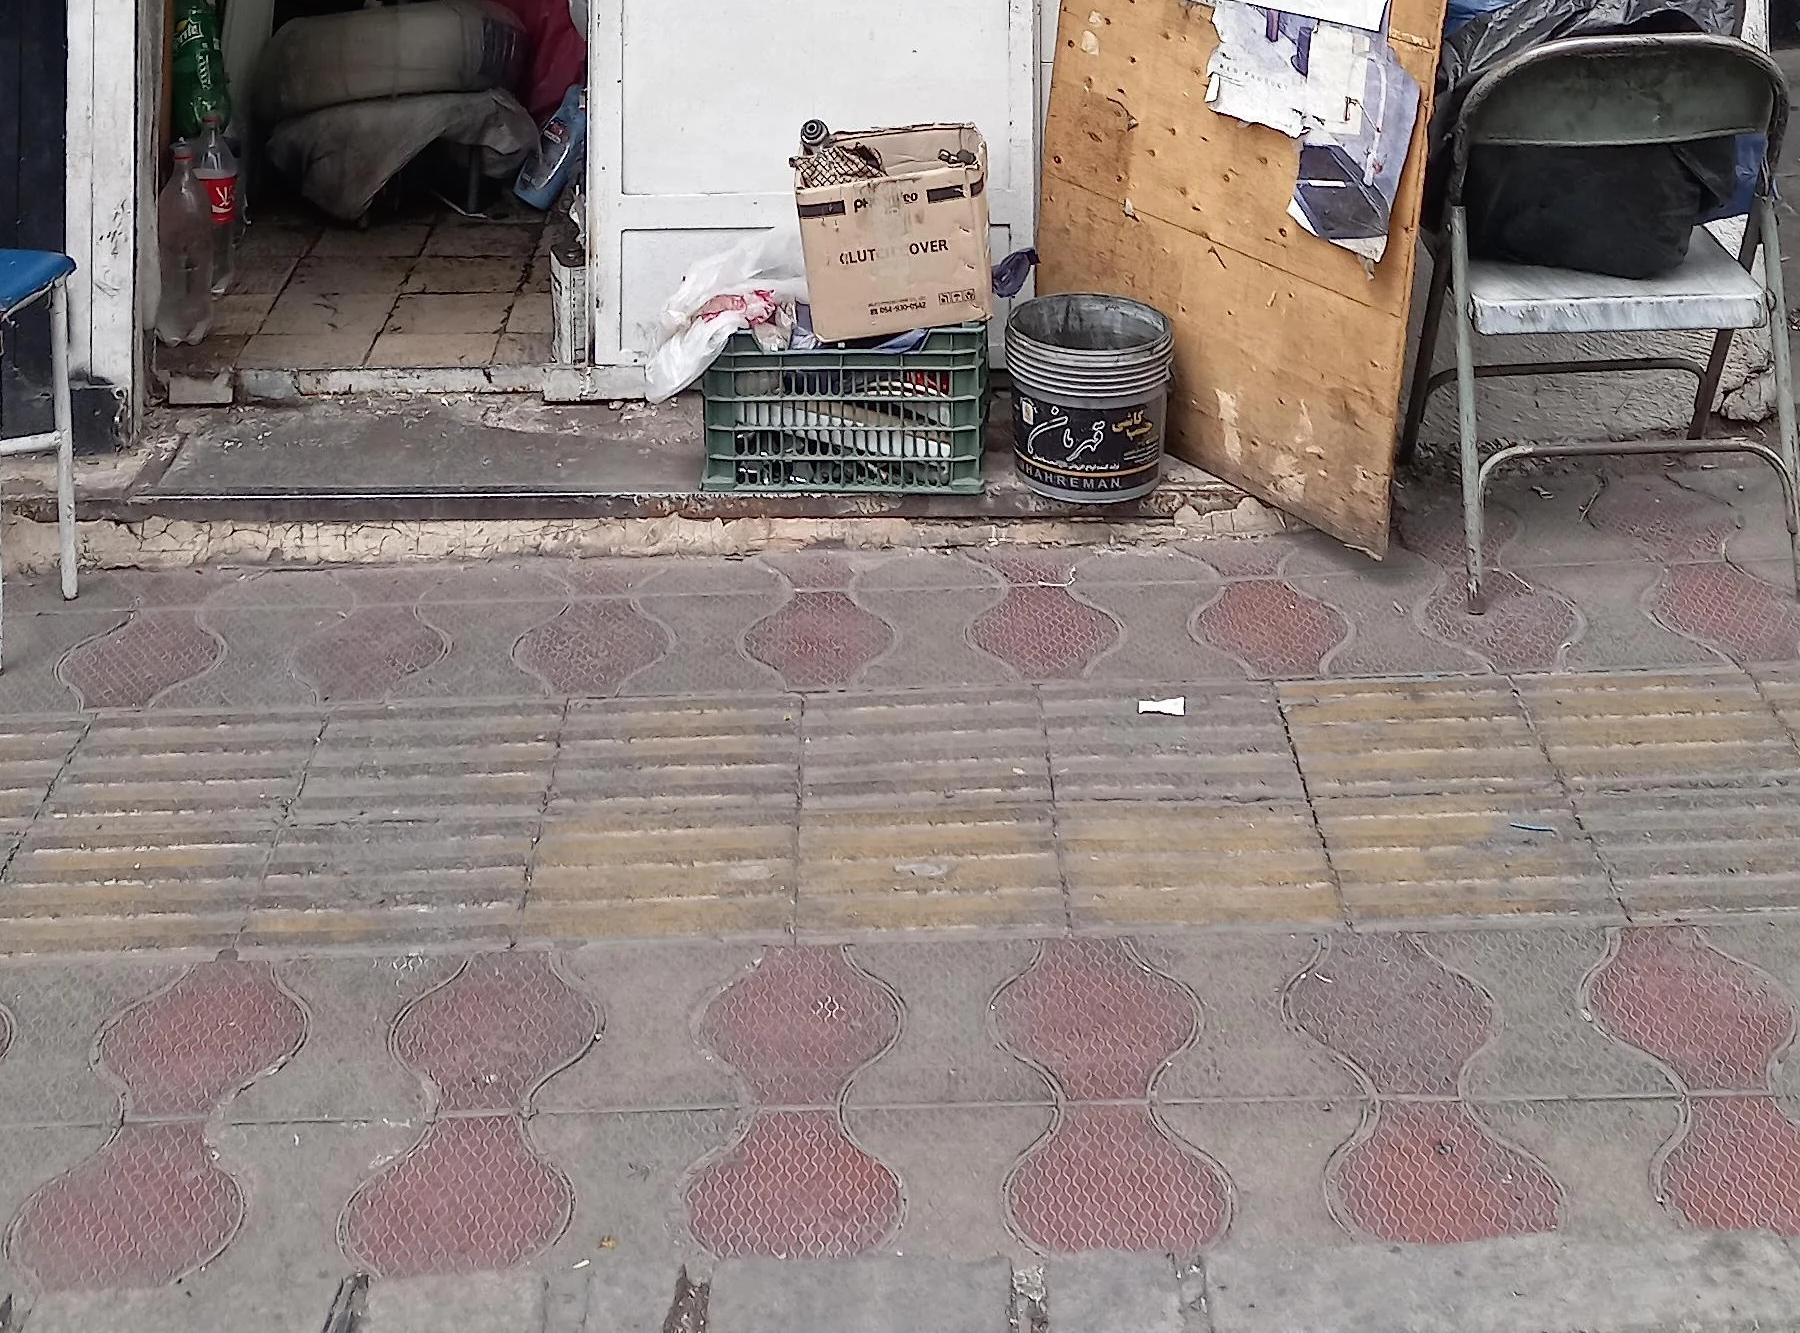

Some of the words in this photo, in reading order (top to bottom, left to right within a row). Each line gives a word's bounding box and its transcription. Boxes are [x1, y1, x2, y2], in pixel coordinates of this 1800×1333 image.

[839, 247, 893, 265] CLUT
[907, 238, 949, 255] OVER
[1024, 461, 1122, 490] HAHREMAN
